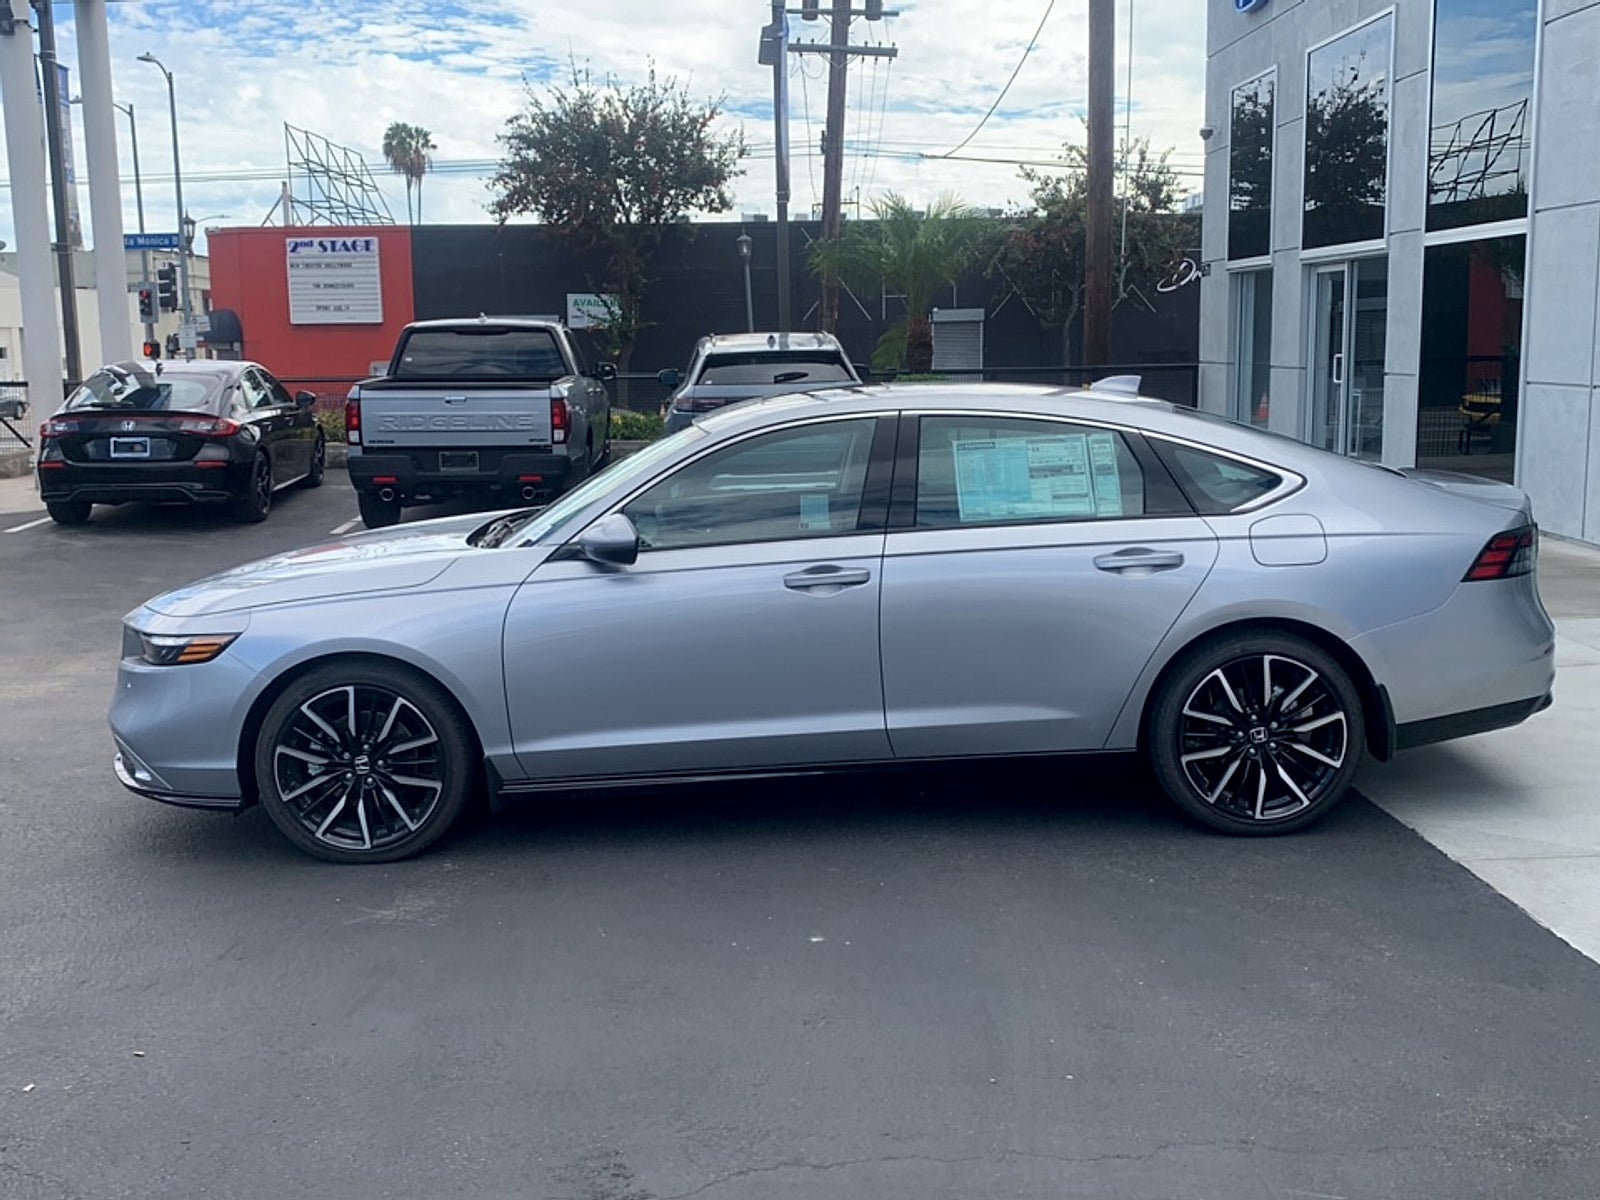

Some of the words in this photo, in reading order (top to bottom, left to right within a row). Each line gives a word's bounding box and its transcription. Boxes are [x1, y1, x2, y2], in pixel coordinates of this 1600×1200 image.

[136, 236, 170, 246] Monica
[289, 239, 315, 254] 2nd
[318, 239, 375, 253] STAGE
[379, 415, 534, 431] RIDGELINE
